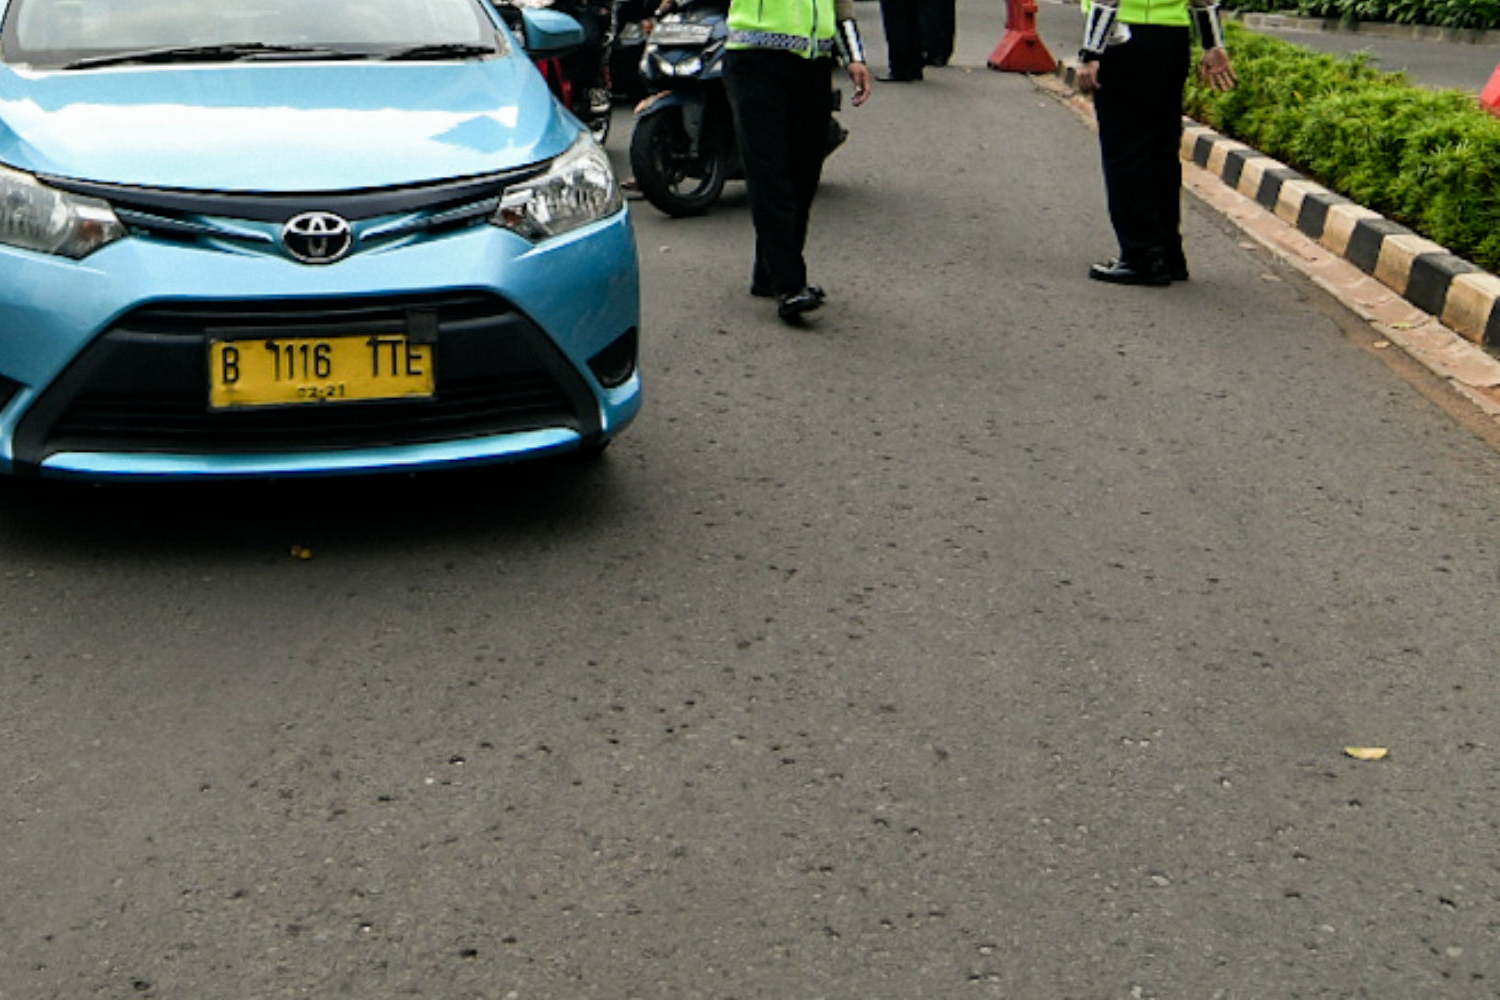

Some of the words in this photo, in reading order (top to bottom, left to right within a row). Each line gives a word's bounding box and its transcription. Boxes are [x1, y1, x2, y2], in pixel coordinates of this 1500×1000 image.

[222, 346, 240, 385] B
[266, 343, 331, 380] 1116
[368, 338, 422, 377] TTE
